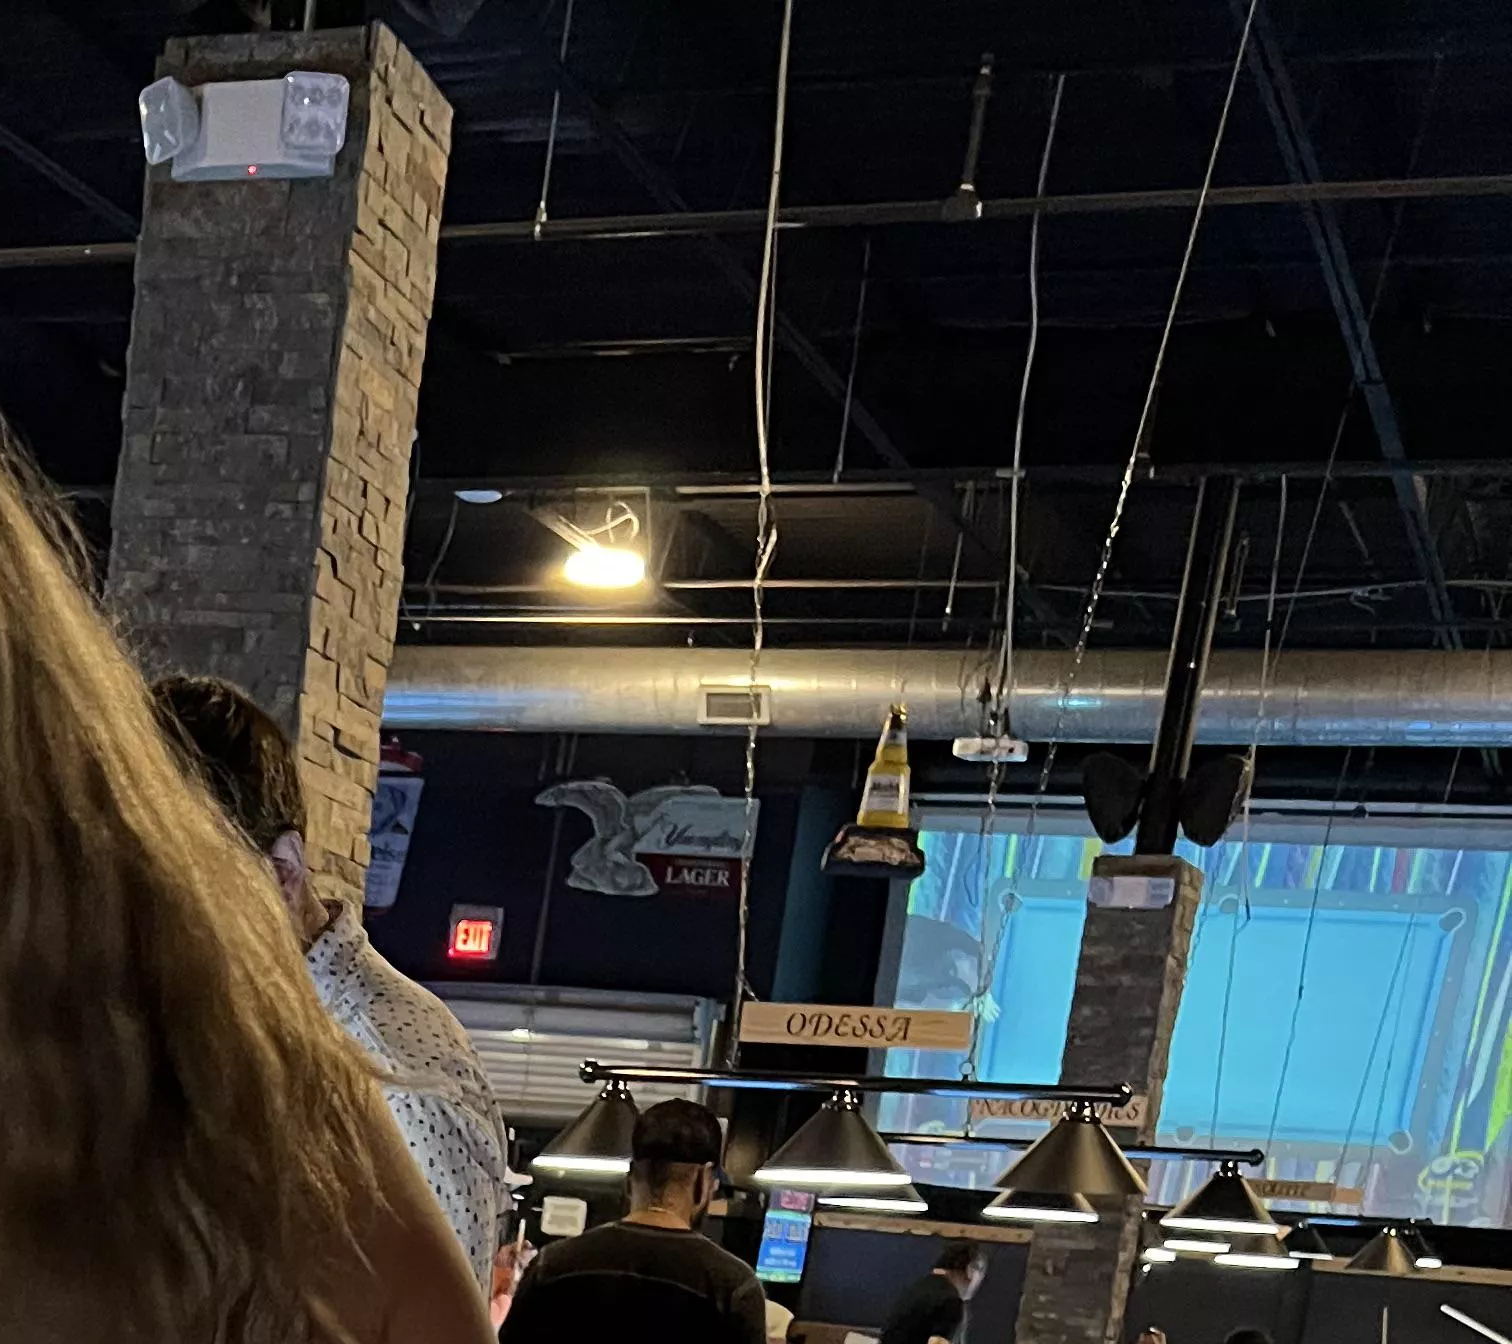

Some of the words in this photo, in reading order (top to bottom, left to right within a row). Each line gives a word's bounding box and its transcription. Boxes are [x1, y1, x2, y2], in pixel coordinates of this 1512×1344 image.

[665, 866, 730, 887] LAGER
[455, 919, 492, 952] EXIT
[786, 1011, 913, 1042] ODESSA
